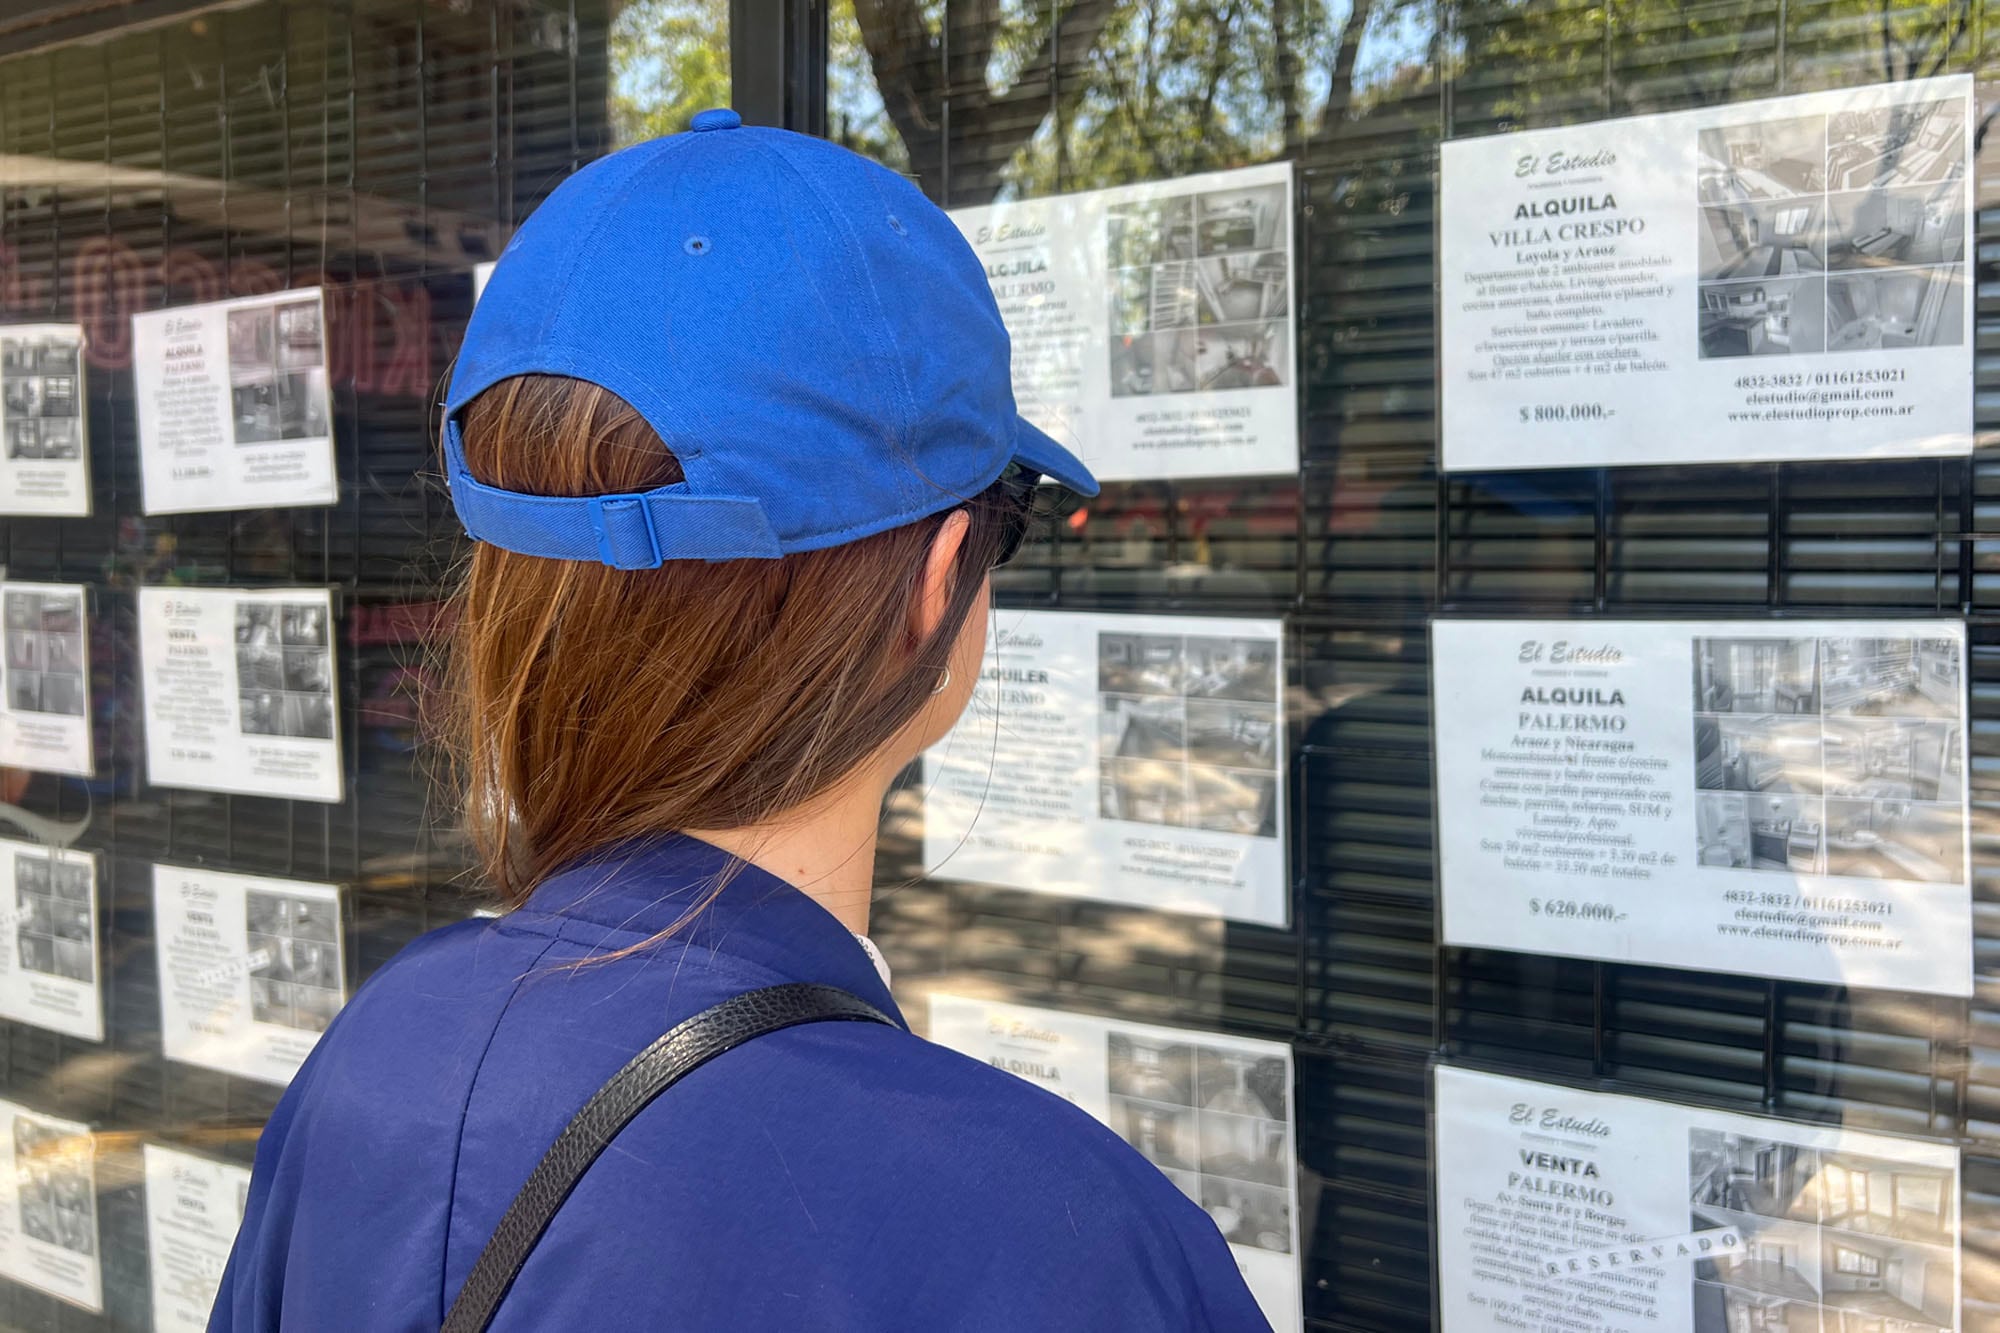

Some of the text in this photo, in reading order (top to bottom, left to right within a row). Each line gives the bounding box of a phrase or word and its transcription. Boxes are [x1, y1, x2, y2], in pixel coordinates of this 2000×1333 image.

[1514, 150, 1616, 178] El Estudio
[1514, 193, 1617, 220] ALQUILA
[1489, 217, 1645, 248] VILLA CRESPO
[1516, 250, 1560, 266] Loyola
[1575, 245, 1616, 260] Araoz
[986, 260, 1048, 278] LQUILA
[994, 280, 1055, 299] ALERMO
[1593, 317, 1643, 331] Lavadero
[1746, 386, 1894, 406] elestudio@gmail.com
[1519, 406, 1530, 424] $
[1727, 403, 1915, 423] www.elestudioprop.com.ar
[1518, 640, 1624, 665] El Estudio
[979, 667, 1049, 684] LQUILER
[1520, 686, 1625, 707] ALQUILA
[1518, 712, 1627, 733] PALERMO
[1565, 735, 1635, 752] Nicaragua
[1529, 898, 1540, 916] $
[1735, 907, 1882, 931] elestudio@gmail.com
[1717, 922, 1903, 950] www.elestudioprop.com.ar
[1508, 1103, 1612, 1138] El Estudio
[1519, 1148, 1600, 1179] VENTA
[1508, 1171, 1614, 1207] PALERMO
